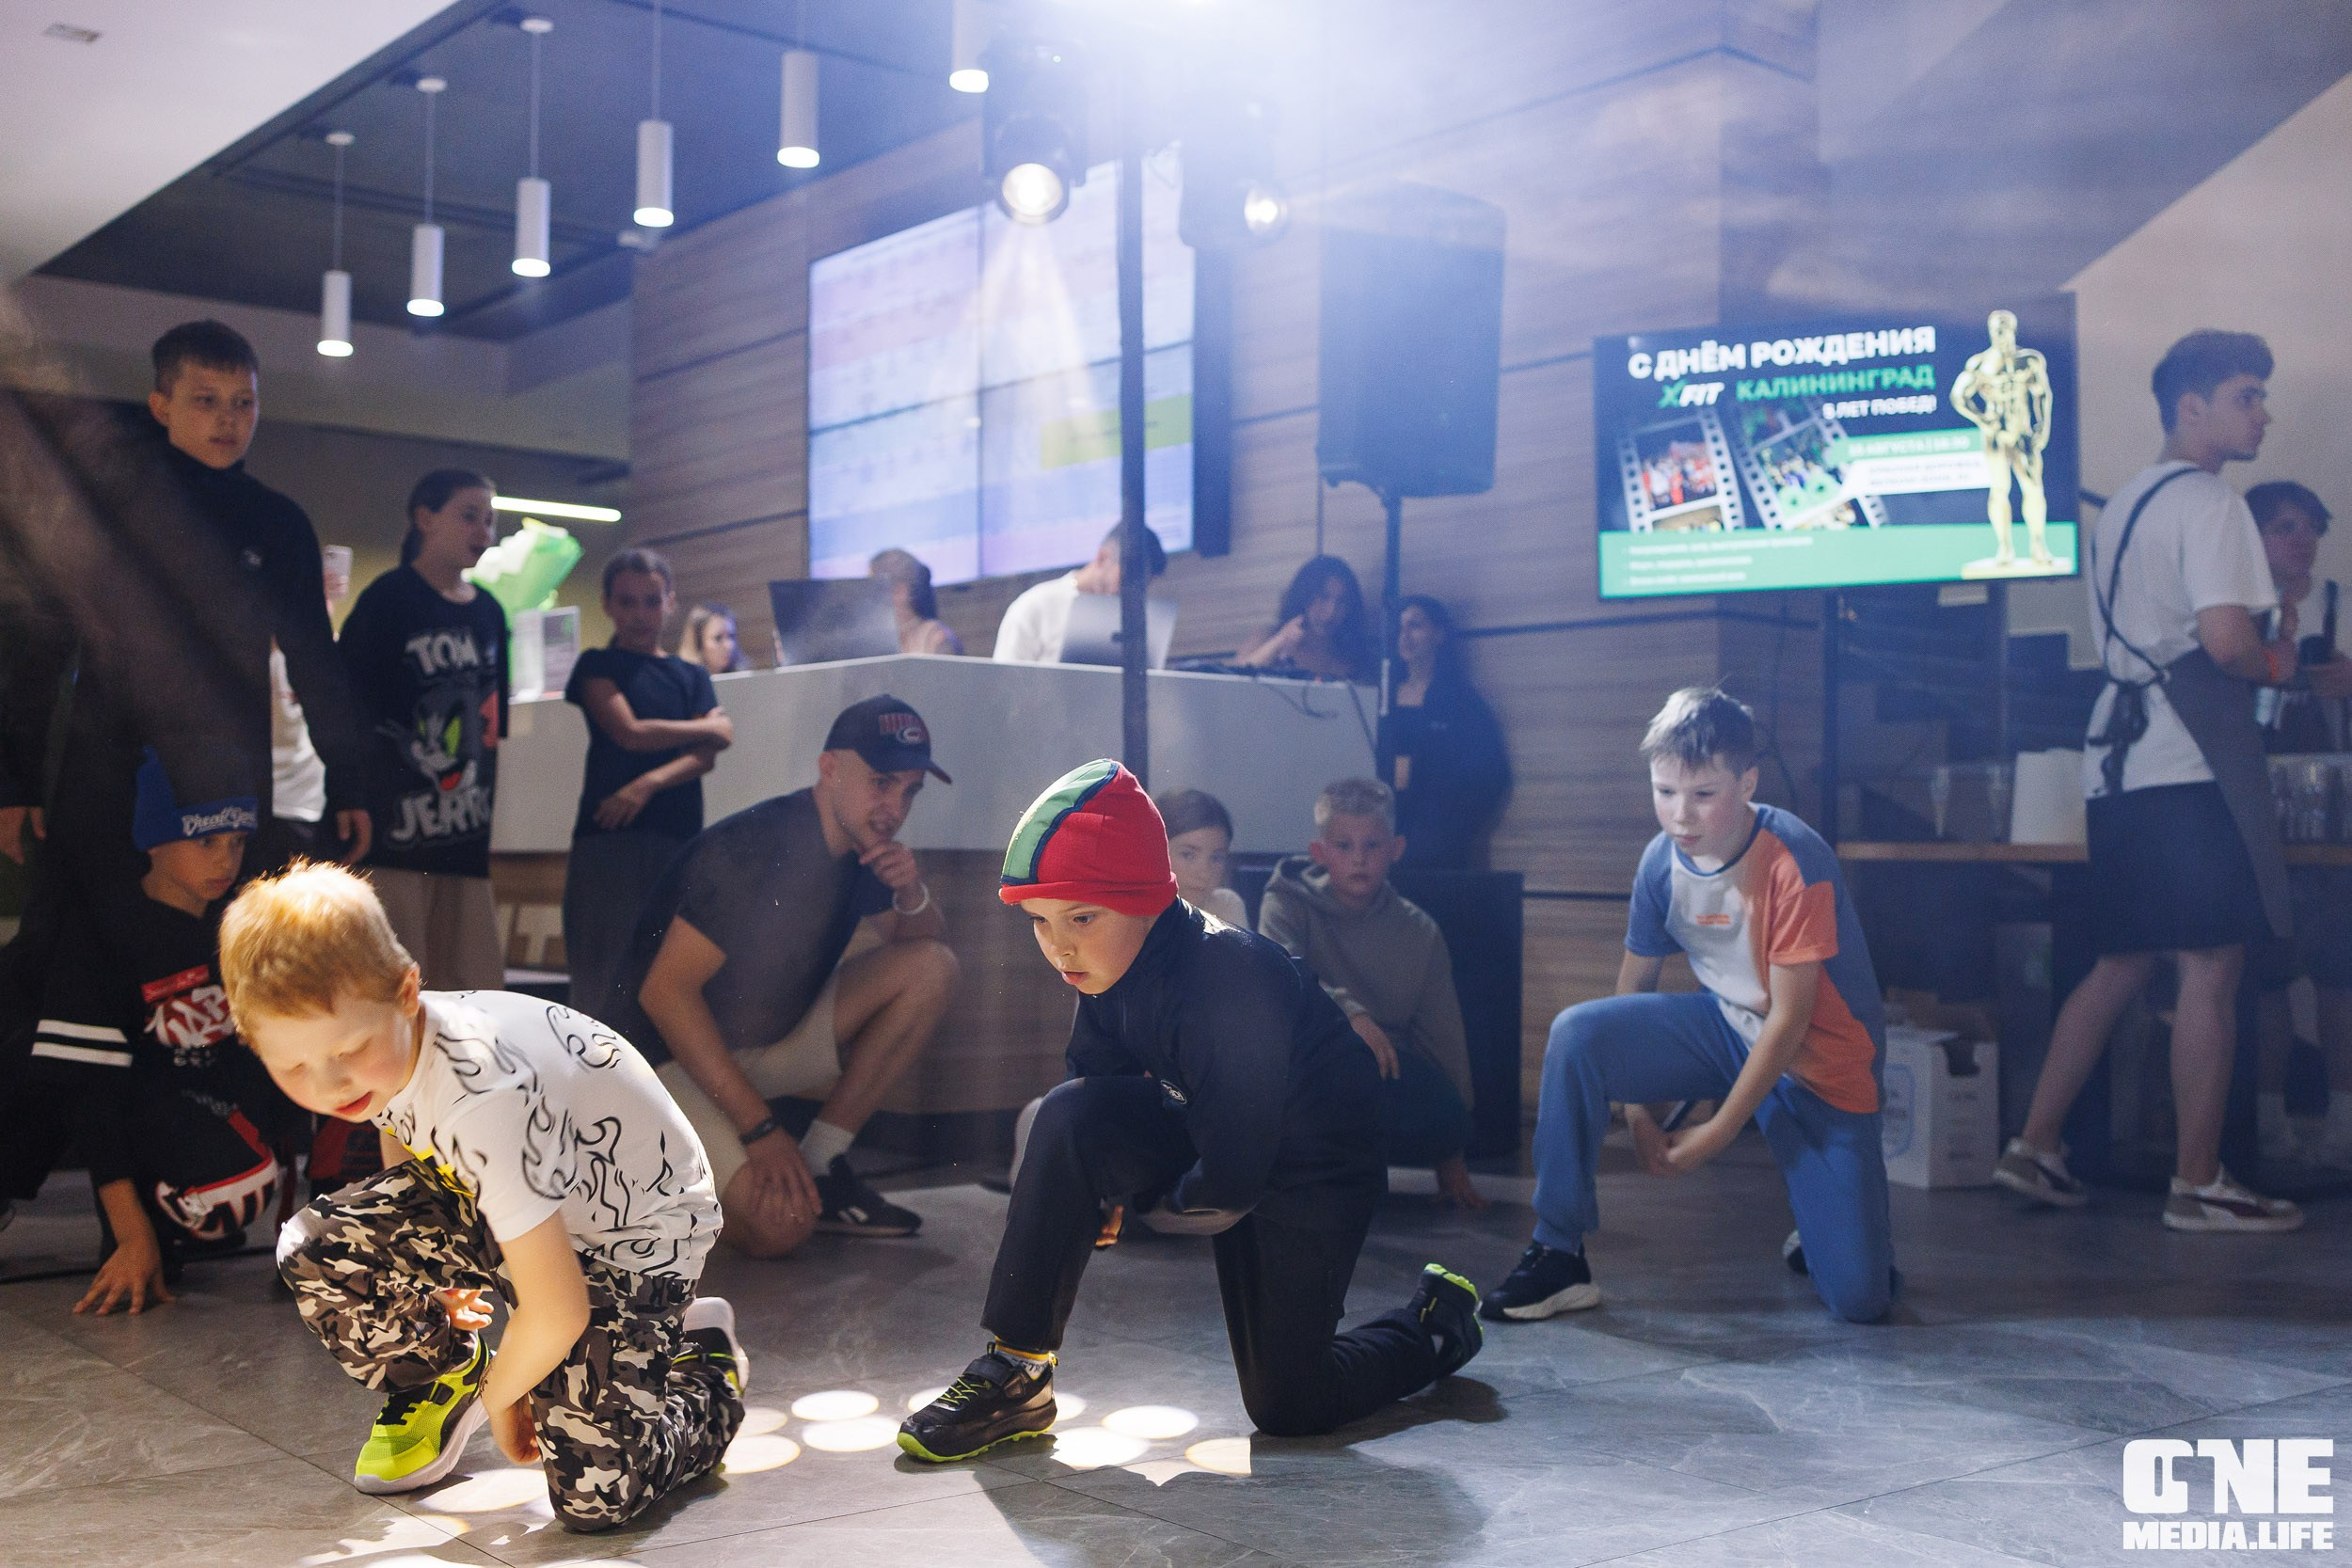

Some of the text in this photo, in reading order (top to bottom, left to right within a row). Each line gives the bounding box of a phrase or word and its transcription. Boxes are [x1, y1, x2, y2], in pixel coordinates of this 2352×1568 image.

[1629, 325, 1936, 381] С ДНЁМ РОЖДЕНИЯ
[1737, 364, 1935, 401] КАЛИНИНГРАД
[1836, 399, 1870, 419] ЛЕТ
[405, 632, 479, 674] TOM
